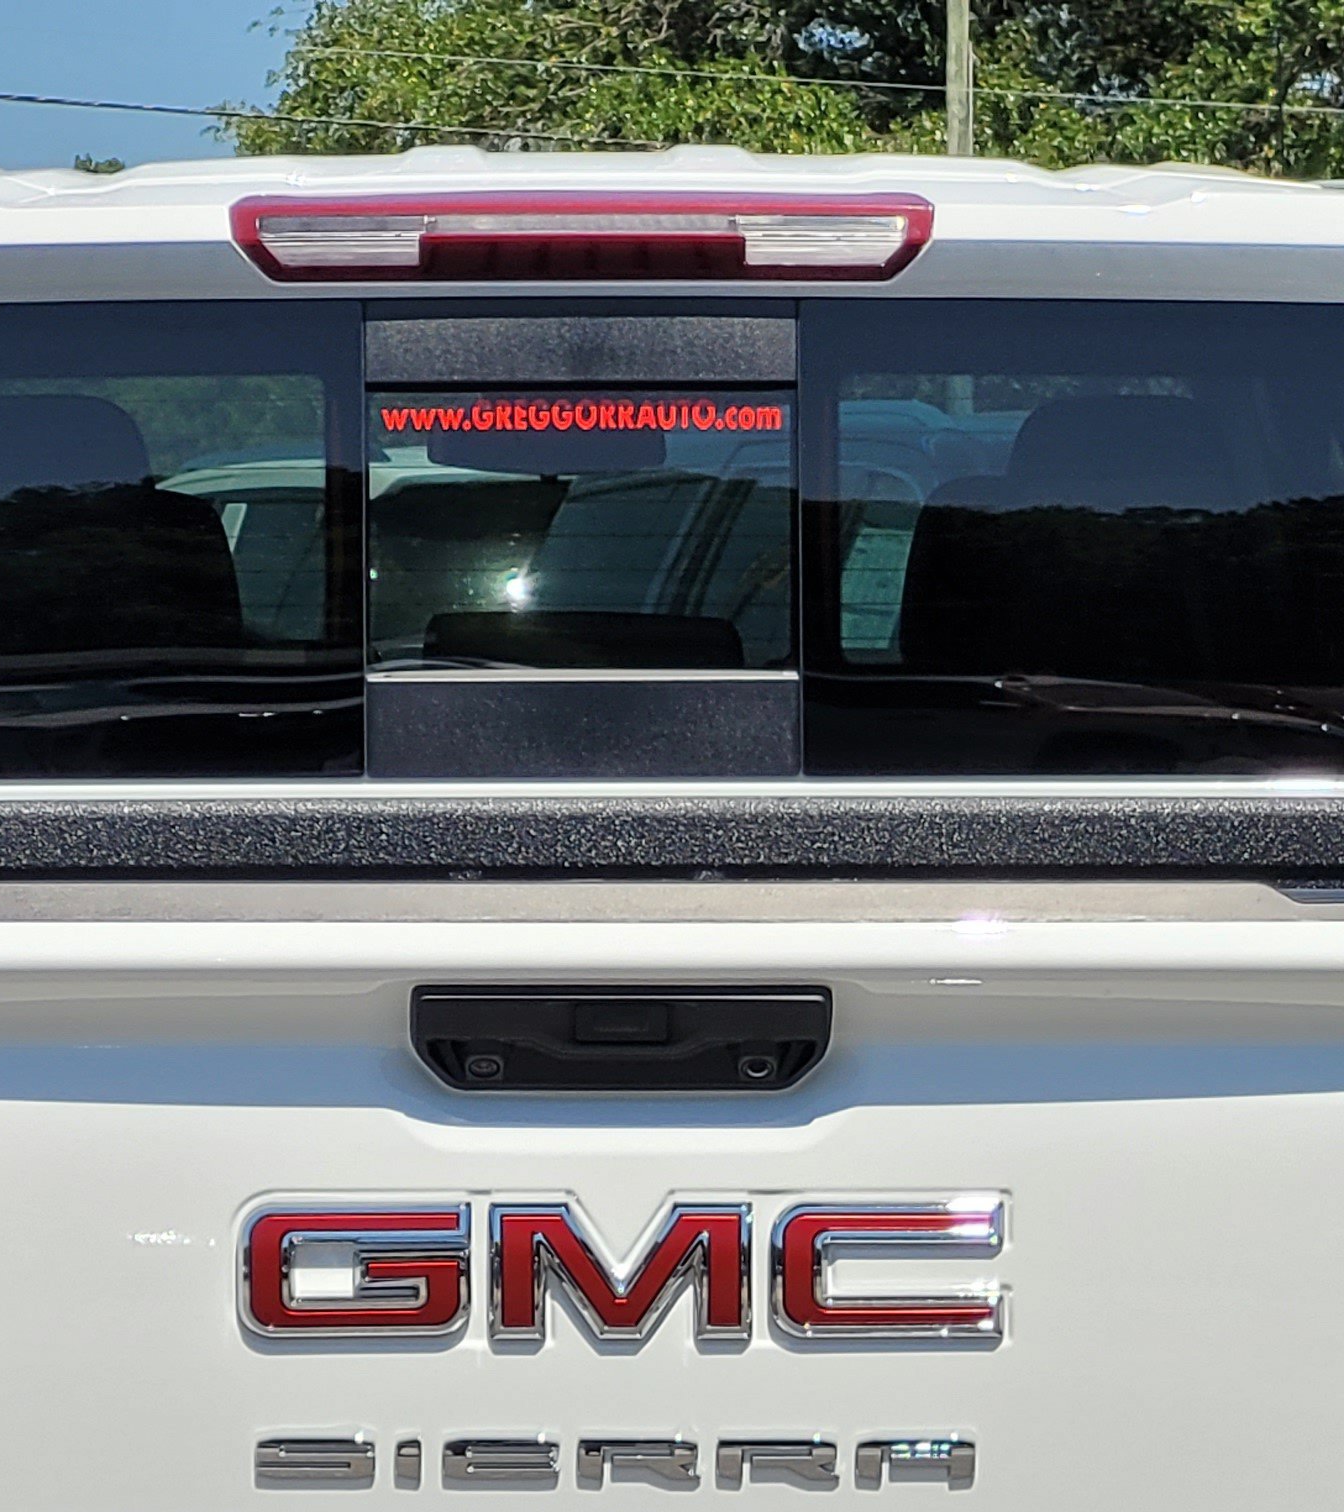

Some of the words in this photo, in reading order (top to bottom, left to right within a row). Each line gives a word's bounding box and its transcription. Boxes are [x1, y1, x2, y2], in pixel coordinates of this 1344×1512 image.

[381, 400, 783, 431] www.GREGGORRAUTO.com
[239, 1198, 1005, 1354] GMC
[256, 1437, 975, 1490] SIERRA
